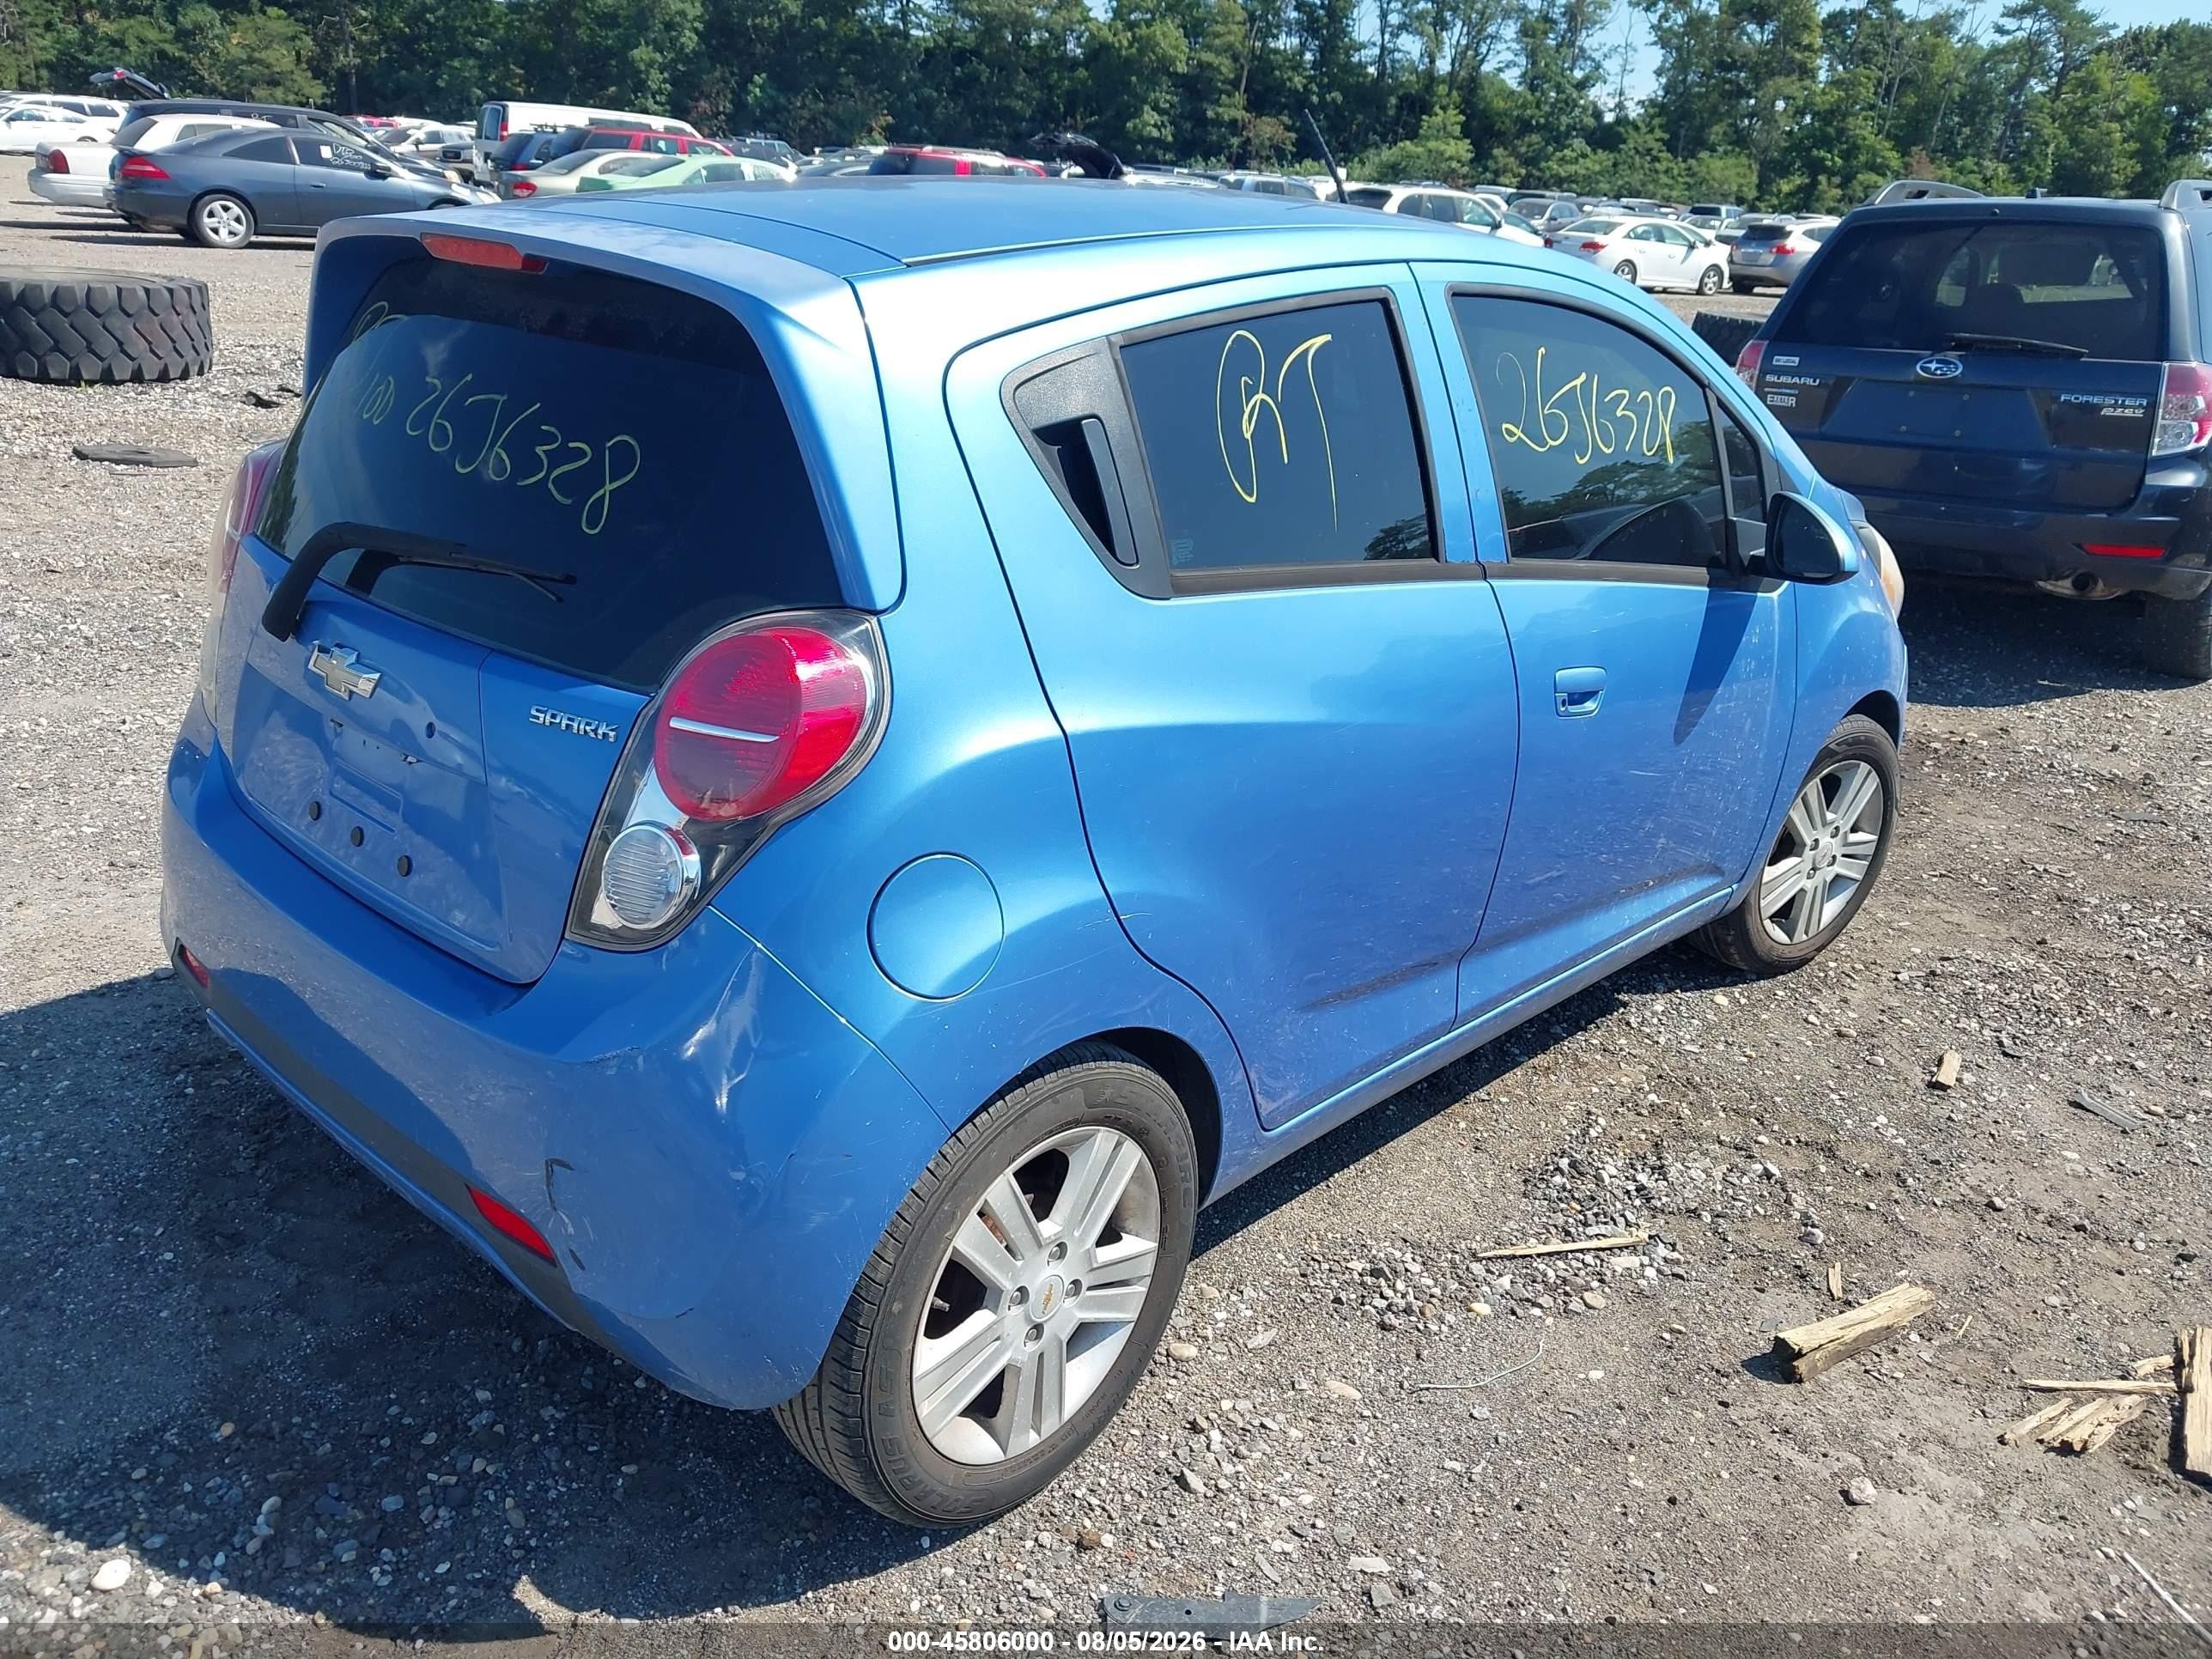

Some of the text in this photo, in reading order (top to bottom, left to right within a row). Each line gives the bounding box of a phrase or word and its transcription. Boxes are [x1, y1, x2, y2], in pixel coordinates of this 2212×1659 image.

[1765, 374, 1820, 386] SUBARU
[2060, 394, 2148, 406] FORESTER
[405, 373, 641, 535] 26J6328
[529, 704, 619, 743] SPARK
